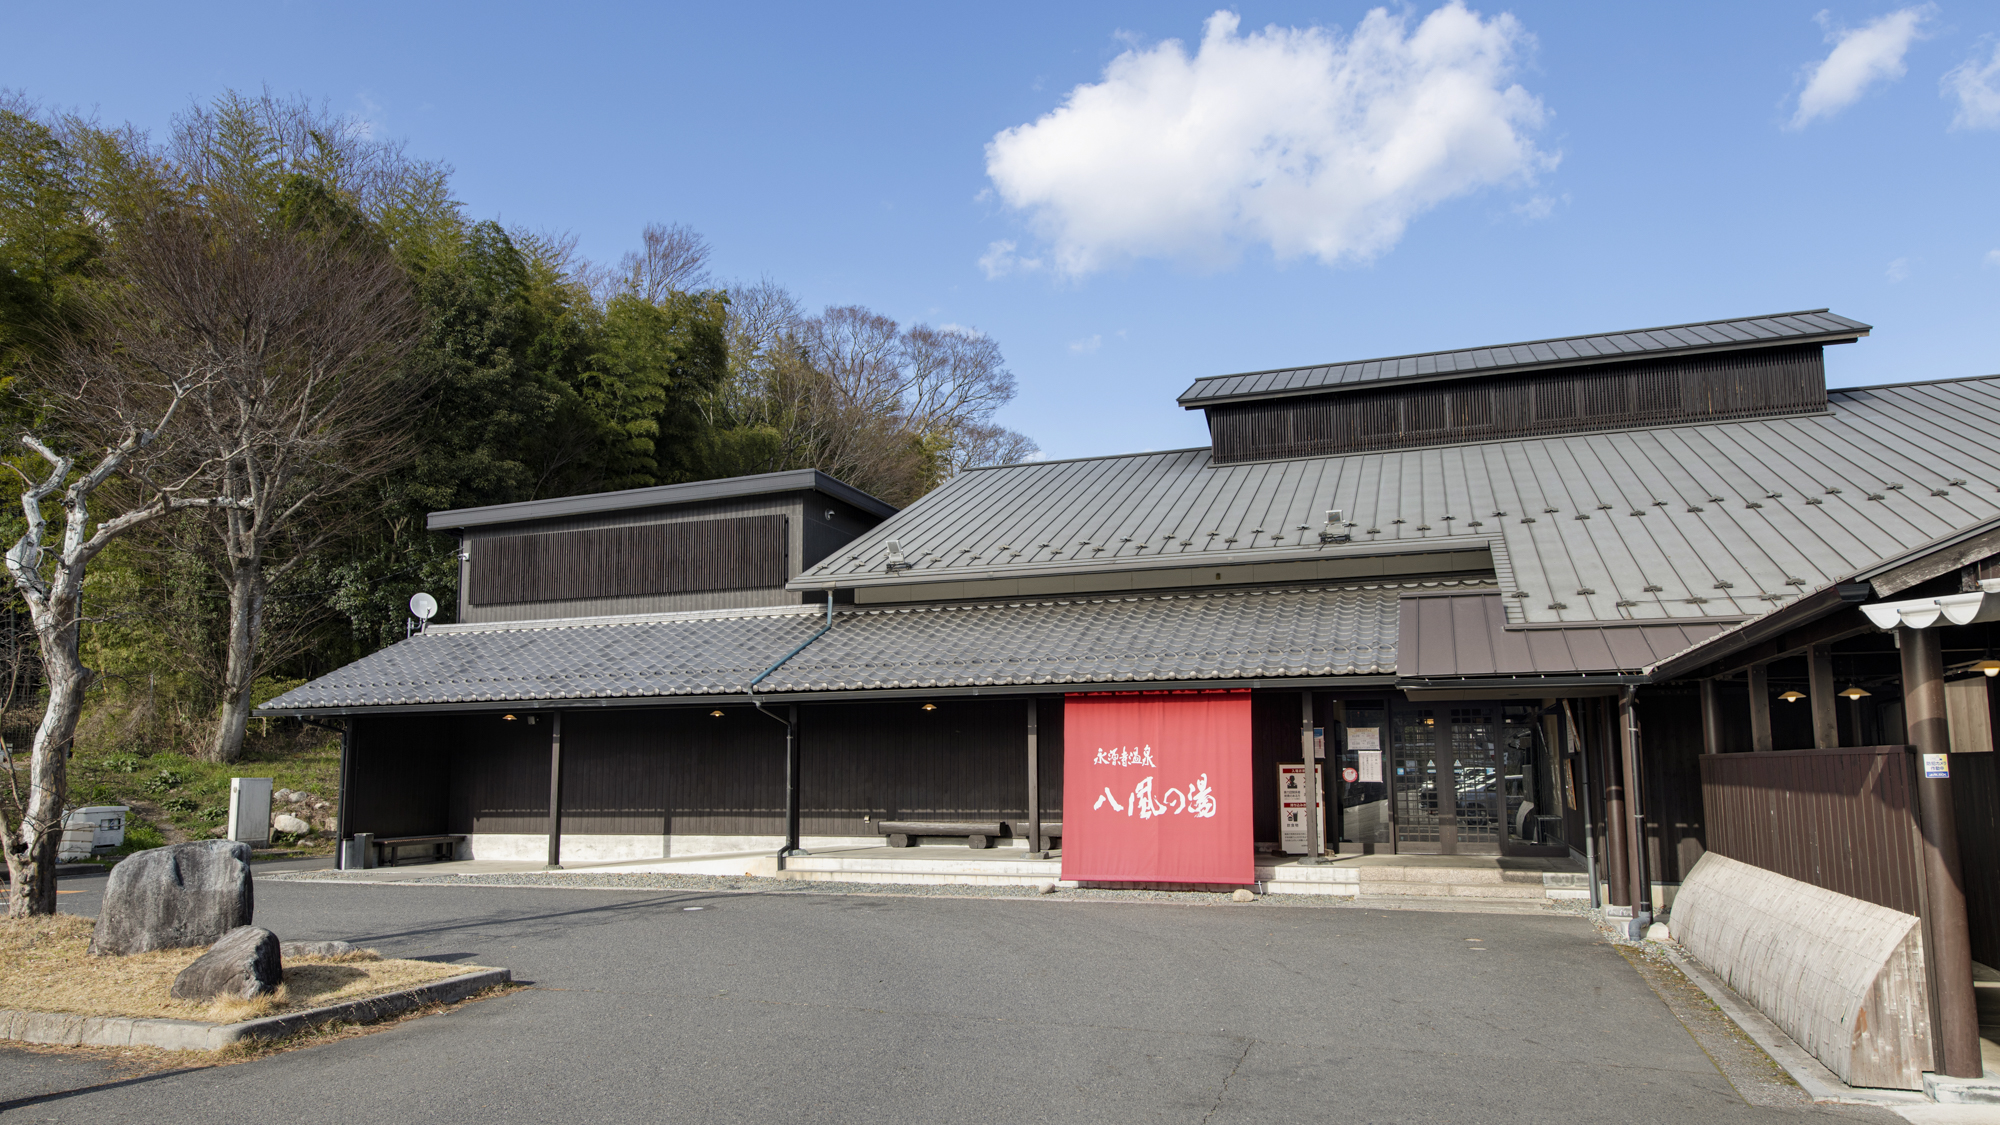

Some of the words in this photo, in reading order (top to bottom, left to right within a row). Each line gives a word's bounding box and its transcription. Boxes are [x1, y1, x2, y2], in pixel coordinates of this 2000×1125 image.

[1093, 744, 1157, 768] 永源寺温泉
[1093, 772, 1217, 820] 八風の湯
